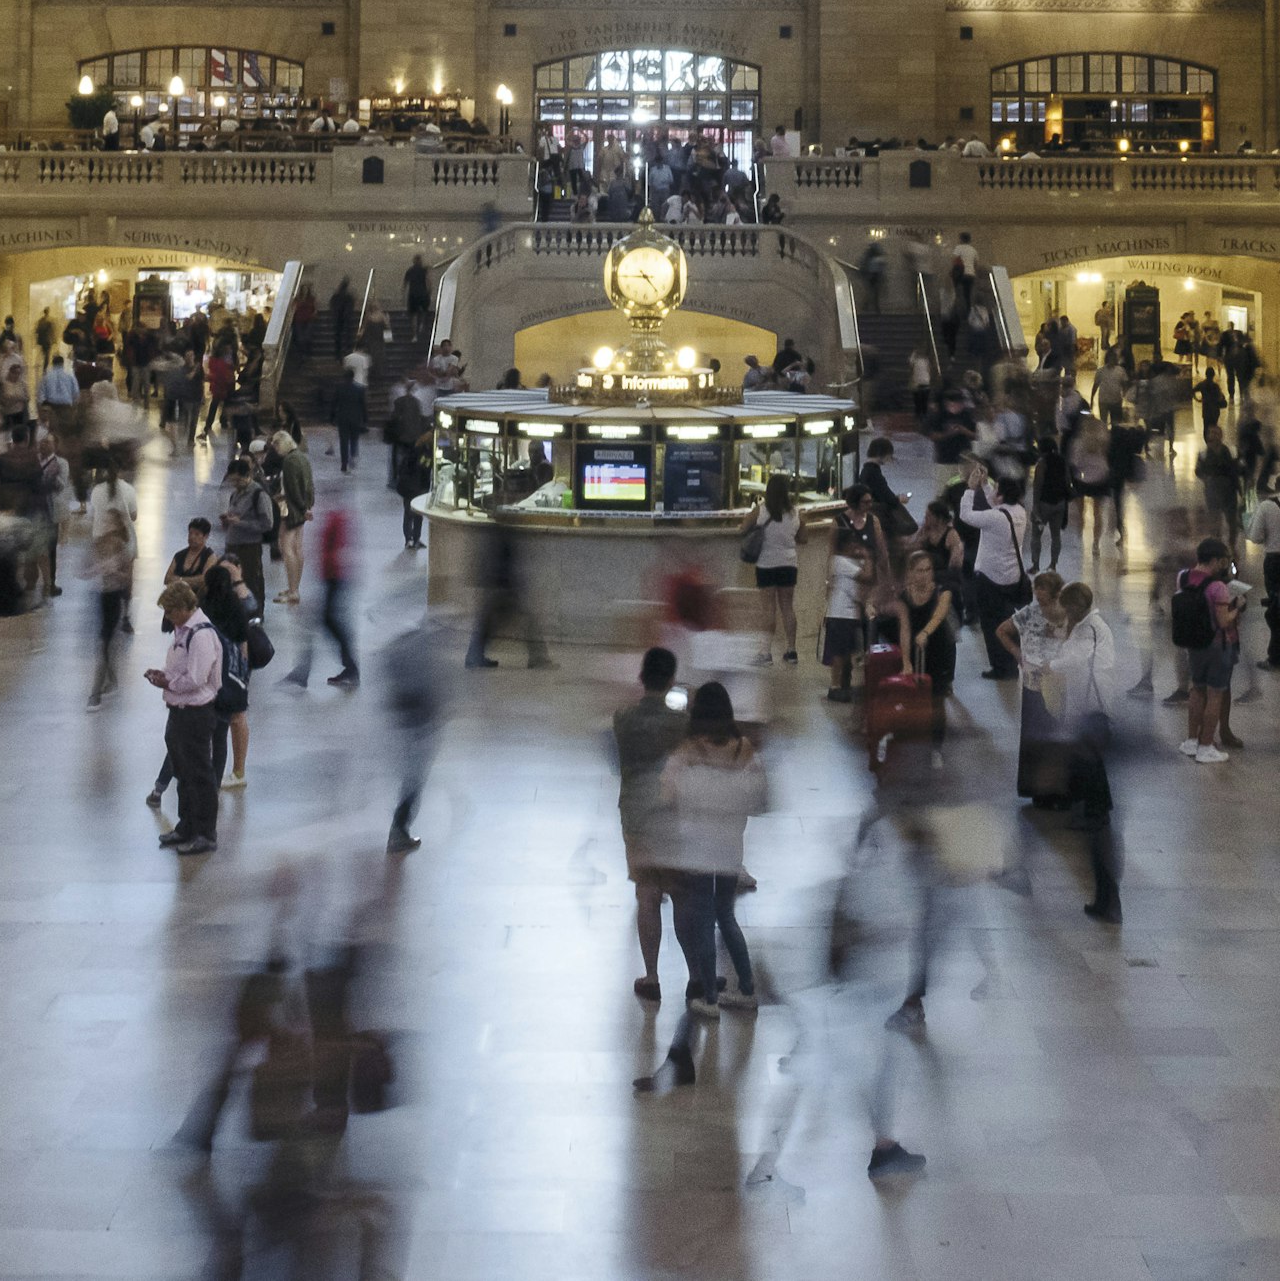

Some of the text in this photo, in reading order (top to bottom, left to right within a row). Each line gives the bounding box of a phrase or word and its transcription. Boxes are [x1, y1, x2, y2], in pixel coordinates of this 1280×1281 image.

[347, 223, 430, 232] WEST BALCONY
[123, 231, 251, 257] SUBWAY 42ND ST
[1041, 238, 1170, 263] TICKET MACHINES
[1221, 238, 1276, 253] TRACKS
[103, 254, 154, 266] SUBWAY
[1127, 259, 1222, 279] WAITING ROOM
[621, 374, 689, 390] Information
